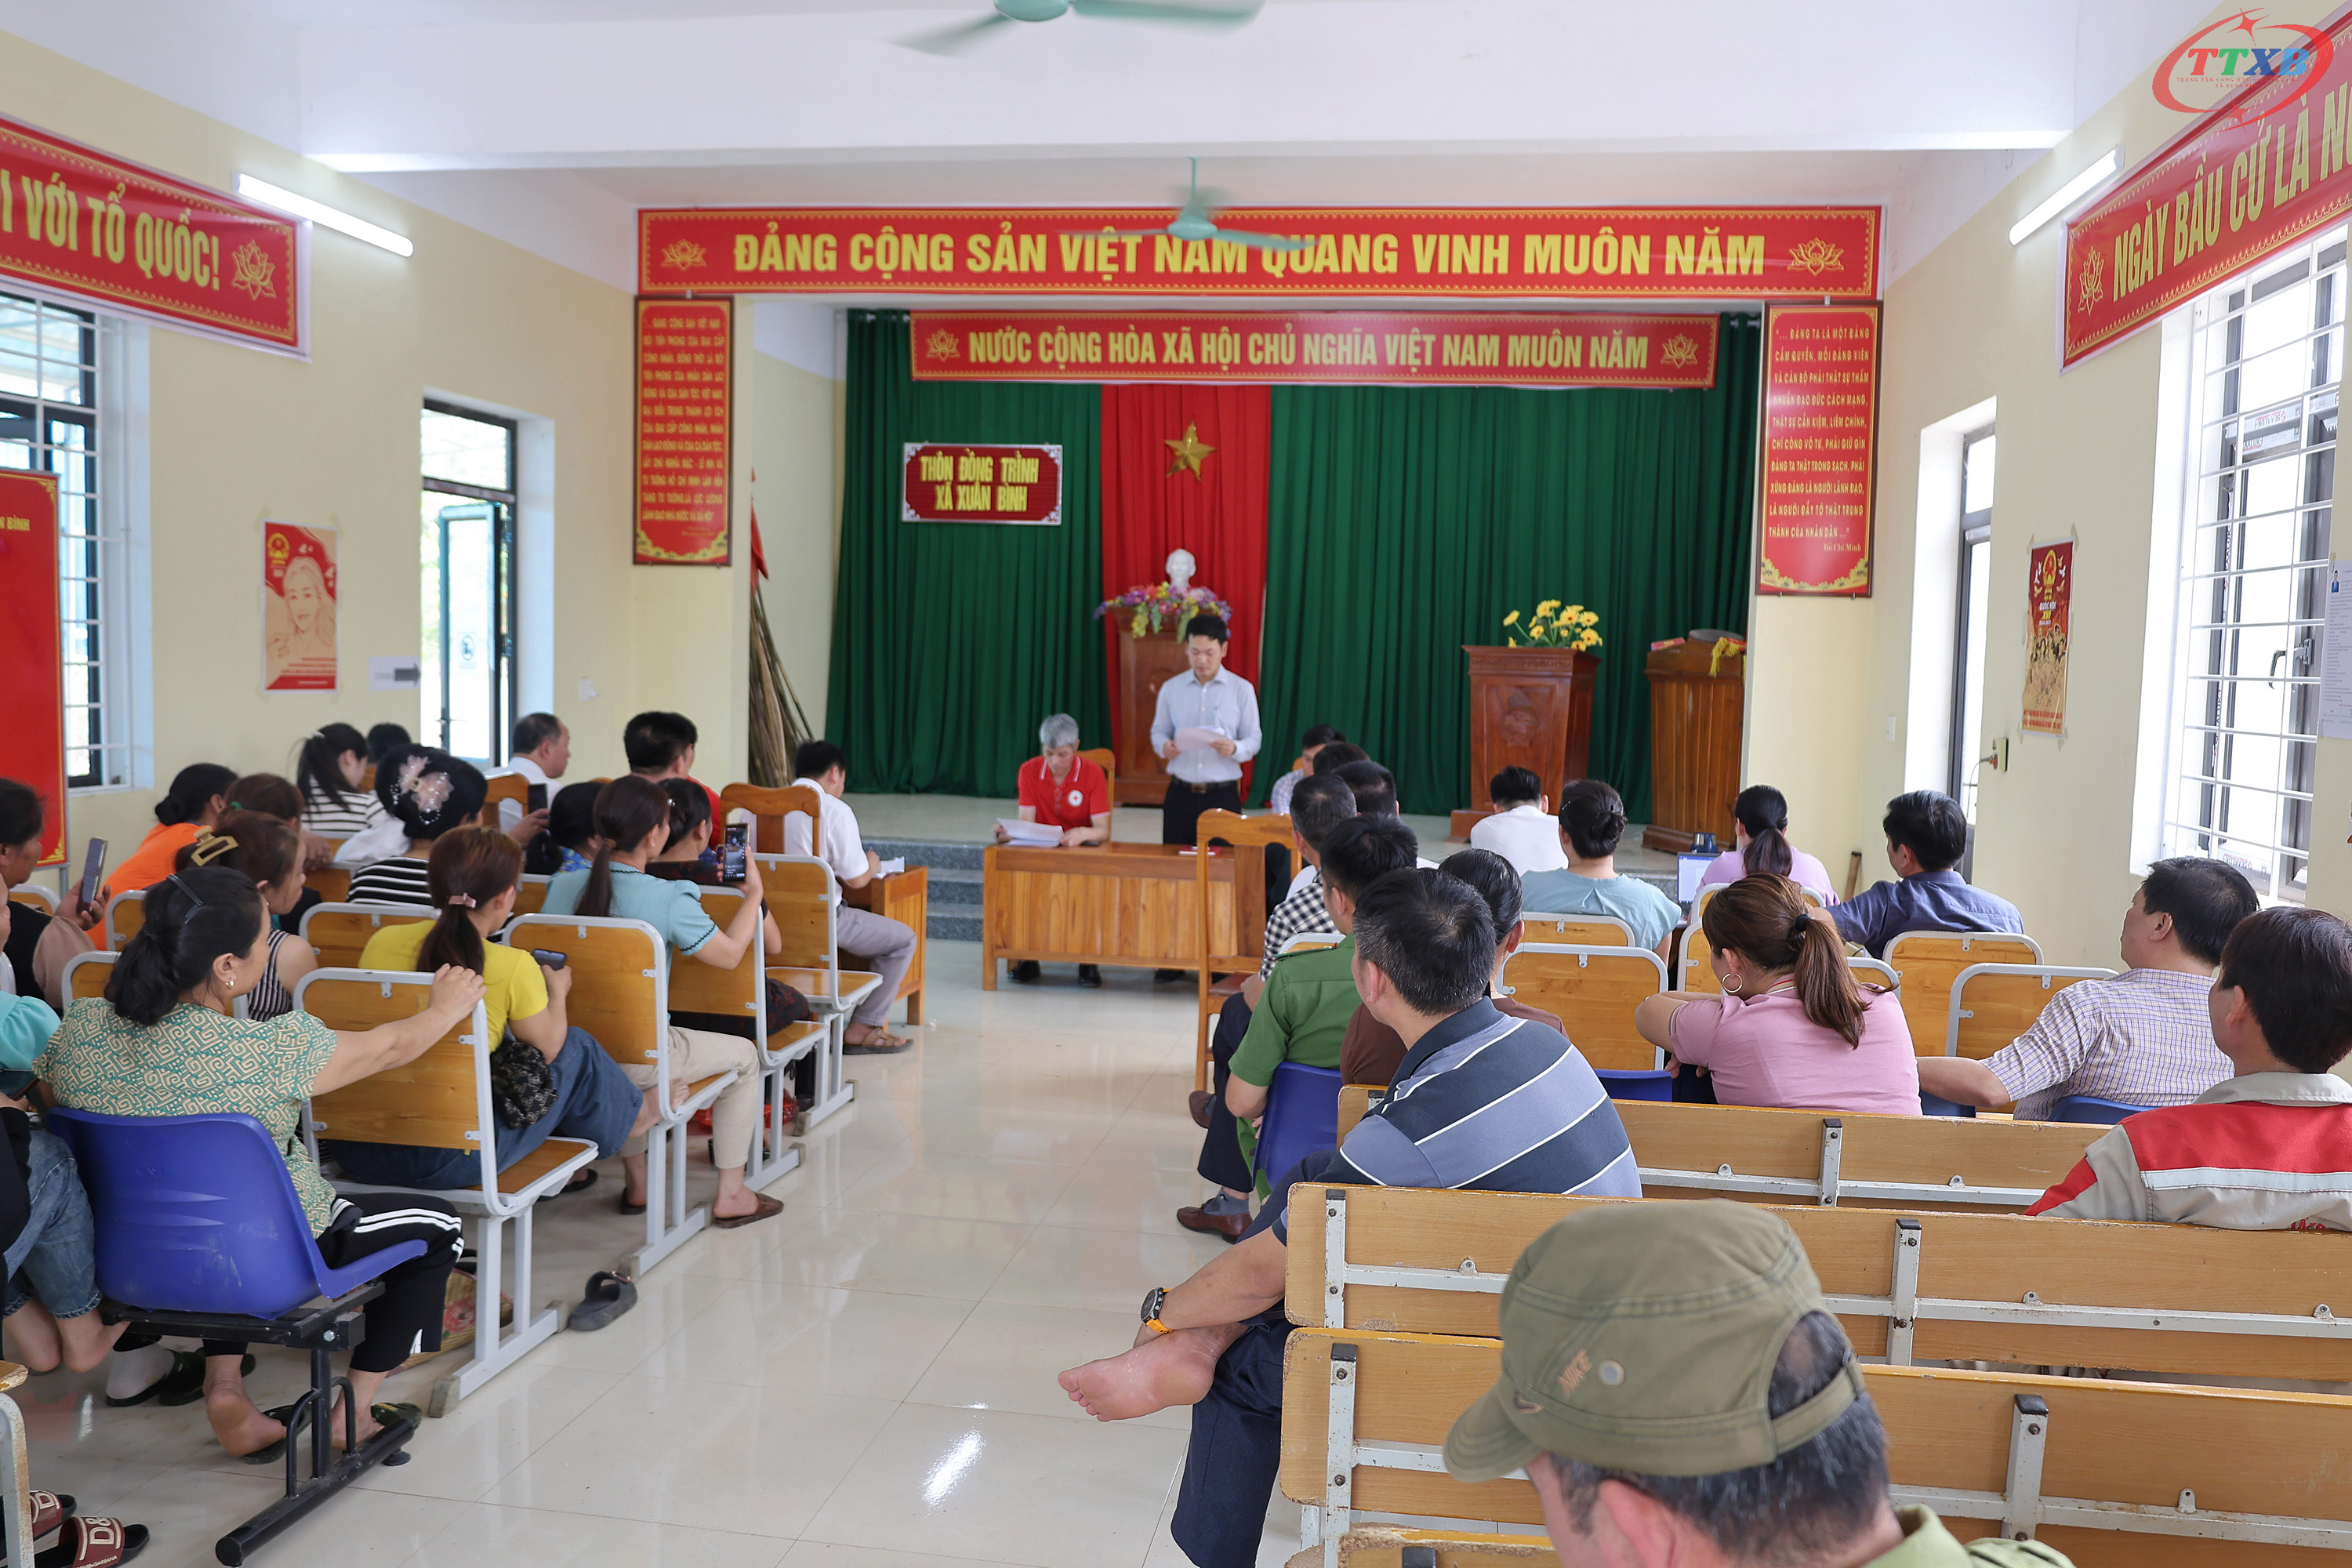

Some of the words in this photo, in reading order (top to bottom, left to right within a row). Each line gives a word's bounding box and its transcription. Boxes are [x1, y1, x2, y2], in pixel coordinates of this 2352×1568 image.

[2113, 199, 2170, 303] NGÀY
[2173, 151, 2224, 267] BẦU
[2229, 111, 2272, 233] CỬ
[2274, 93, 2310, 209] LÀ
[21, 171, 78, 251] VỚI
[87, 183, 127, 264] TỔ
[135, 207, 220, 292] QUỐC!
[734, 222, 837, 273] ĐẢNG
[849, 225, 954, 280] CỘNG
[967, 222, 1047, 274] SẢN
[1060, 226, 1143, 281] VIỆT
[1154, 234, 1247, 274] NAM
[1261, 233, 1399, 278] QUANG
[1412, 234, 1509, 274] VINH
[1523, 226, 1651, 275] MUÔN
[1664, 226, 1766, 275] NĂM
[968, 325, 1033, 363] NƯỚC
[1038, 325, 1102, 369] CỘNG
[1109, 324, 1156, 364] HÒA
[1162, 326, 1196, 364] XÃ
[1201, 326, 1241, 371] HỘI
[1248, 322, 1297, 365] CHỦ
[1304, 328, 1377, 366] NGHĨA
[1384, 328, 1436, 372] VIỆT
[1443, 333, 1501, 367] NAM
[1508, 328, 1585, 368] MUÔN
[1589, 328, 1649, 368] NĂM
[1812, 328, 1820, 339] TA
[920, 450, 954, 482] THÔN
[1000, 450, 1040, 484] TRÌNH
[956, 481, 992, 511] XUÂN
[997, 481, 1028, 512] BÌNH
[1842, 504, 1864, 515] TRUNG
[1558, 1348, 1592, 1397] NIKE
